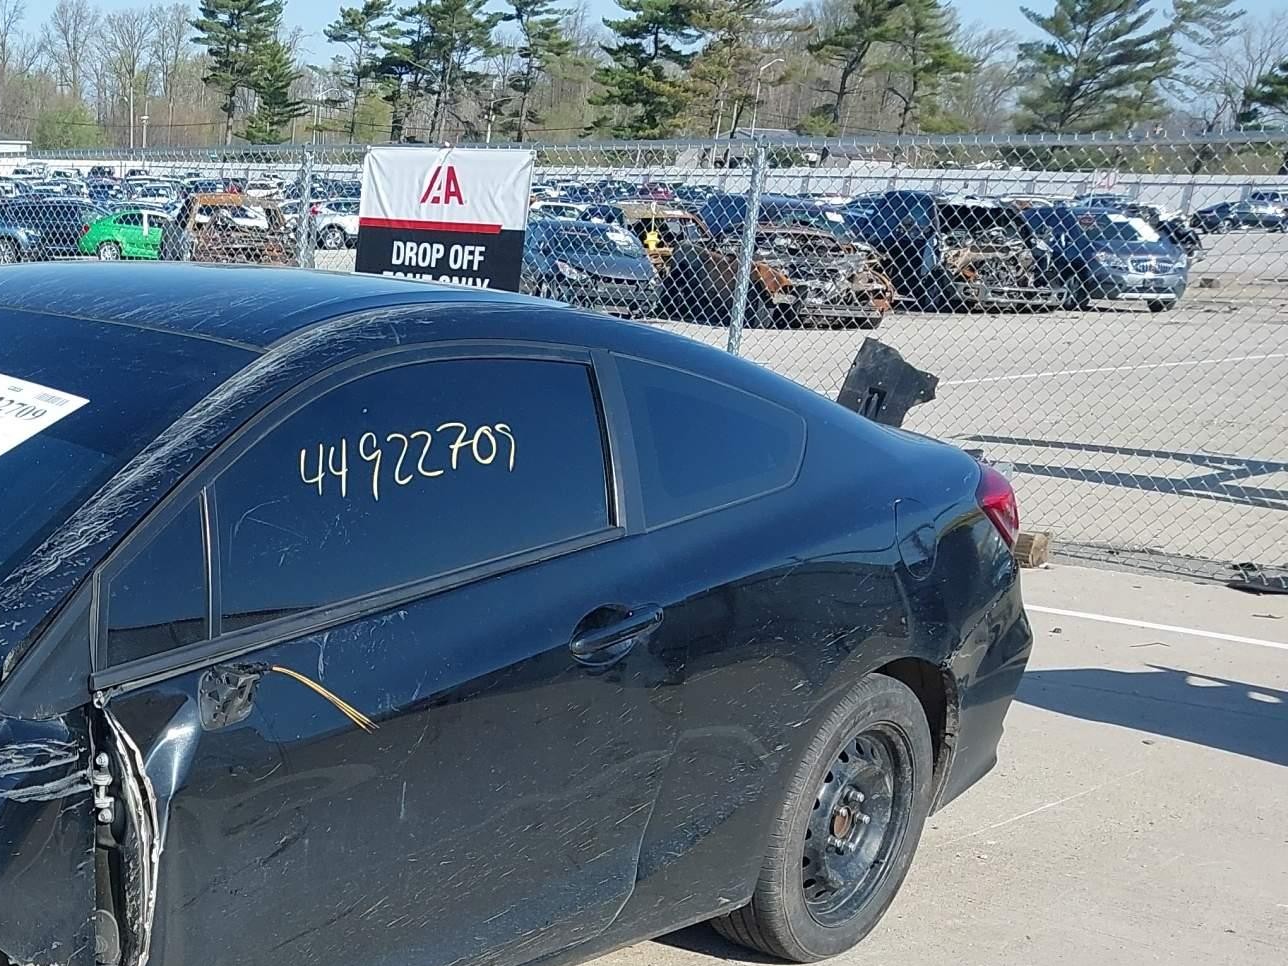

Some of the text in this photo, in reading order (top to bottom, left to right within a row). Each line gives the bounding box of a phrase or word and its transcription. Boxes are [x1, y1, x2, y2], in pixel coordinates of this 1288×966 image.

[391, 240, 486, 271] DROP OFF
[300, 422, 515, 501] 44922709
